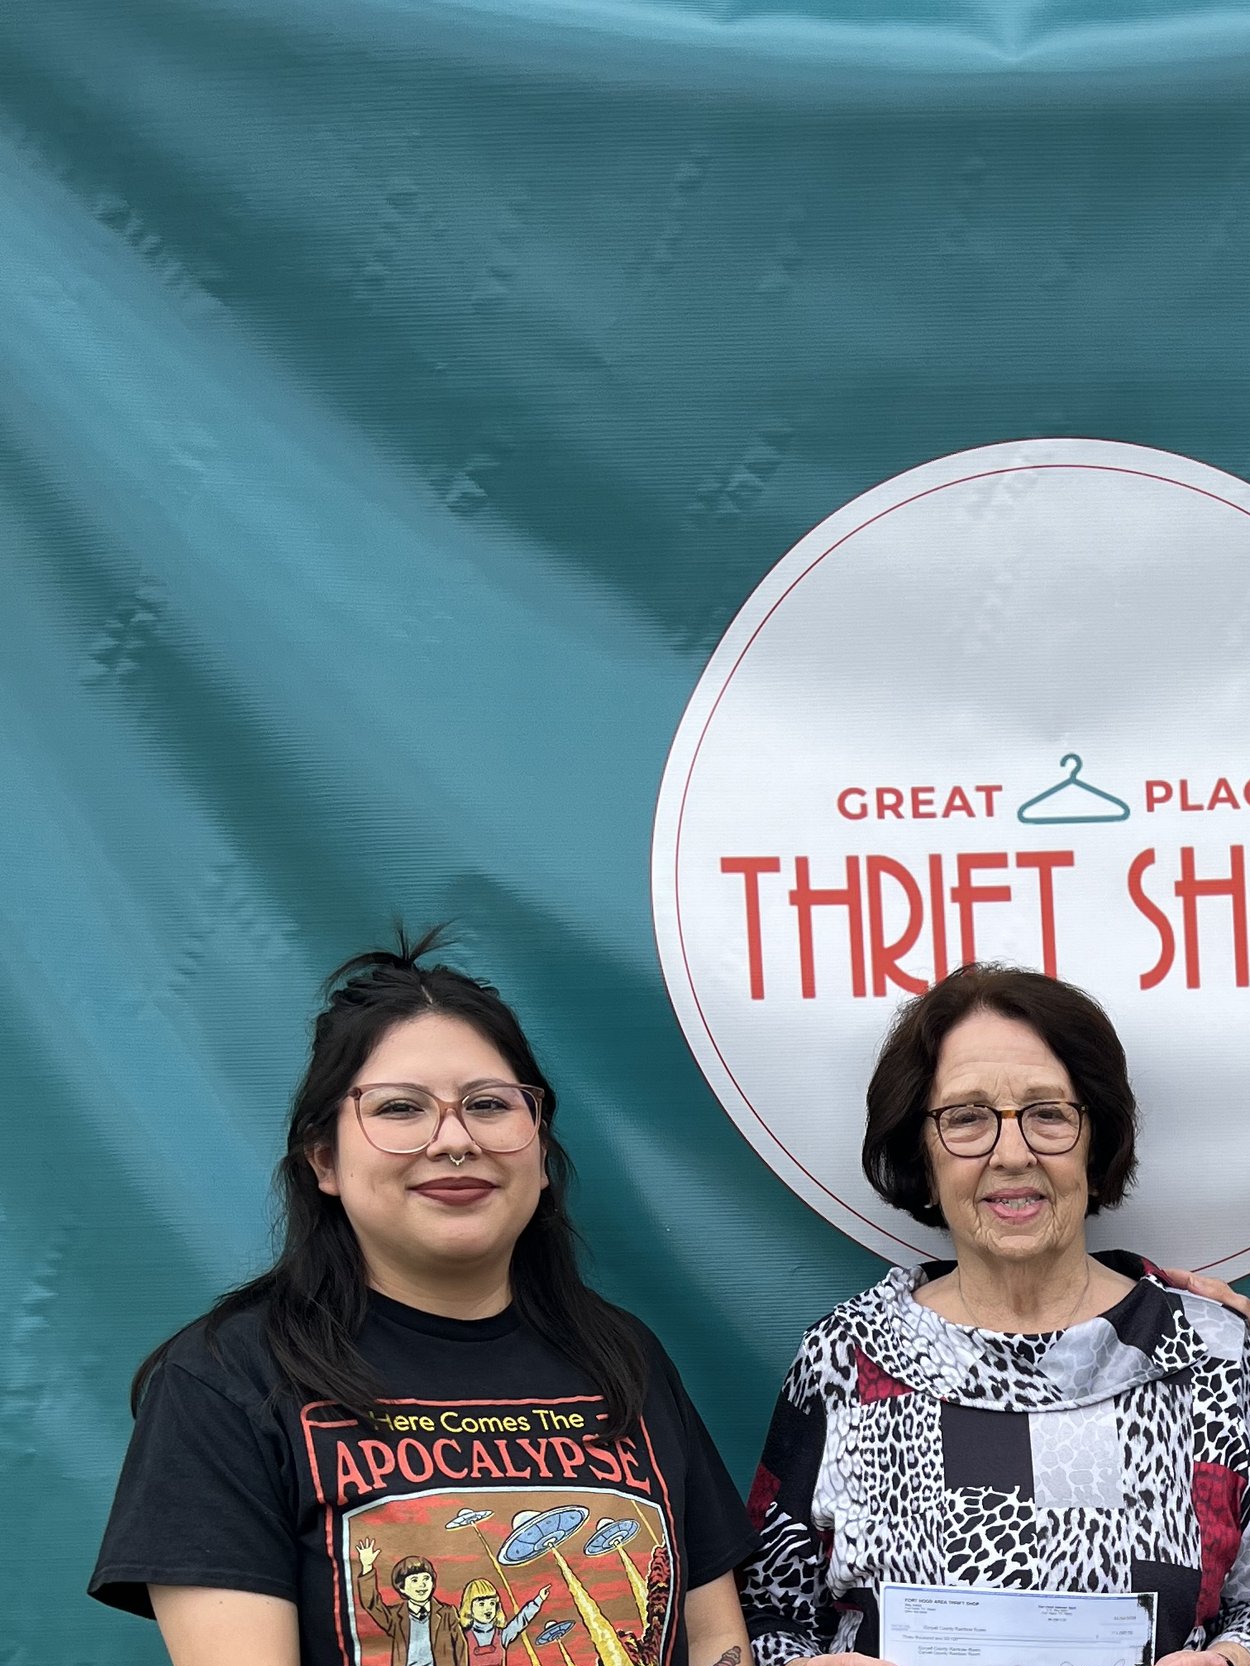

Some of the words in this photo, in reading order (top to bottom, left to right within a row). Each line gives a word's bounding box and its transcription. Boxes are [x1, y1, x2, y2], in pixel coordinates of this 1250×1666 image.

[838, 786, 1002, 820] GREAT
[720, 850, 1075, 1001] THRIFT
[440, 1411, 529, 1433] Comes
[532, 1409, 584, 1431] The
[337, 1433, 652, 1506] APOCALYPSE
